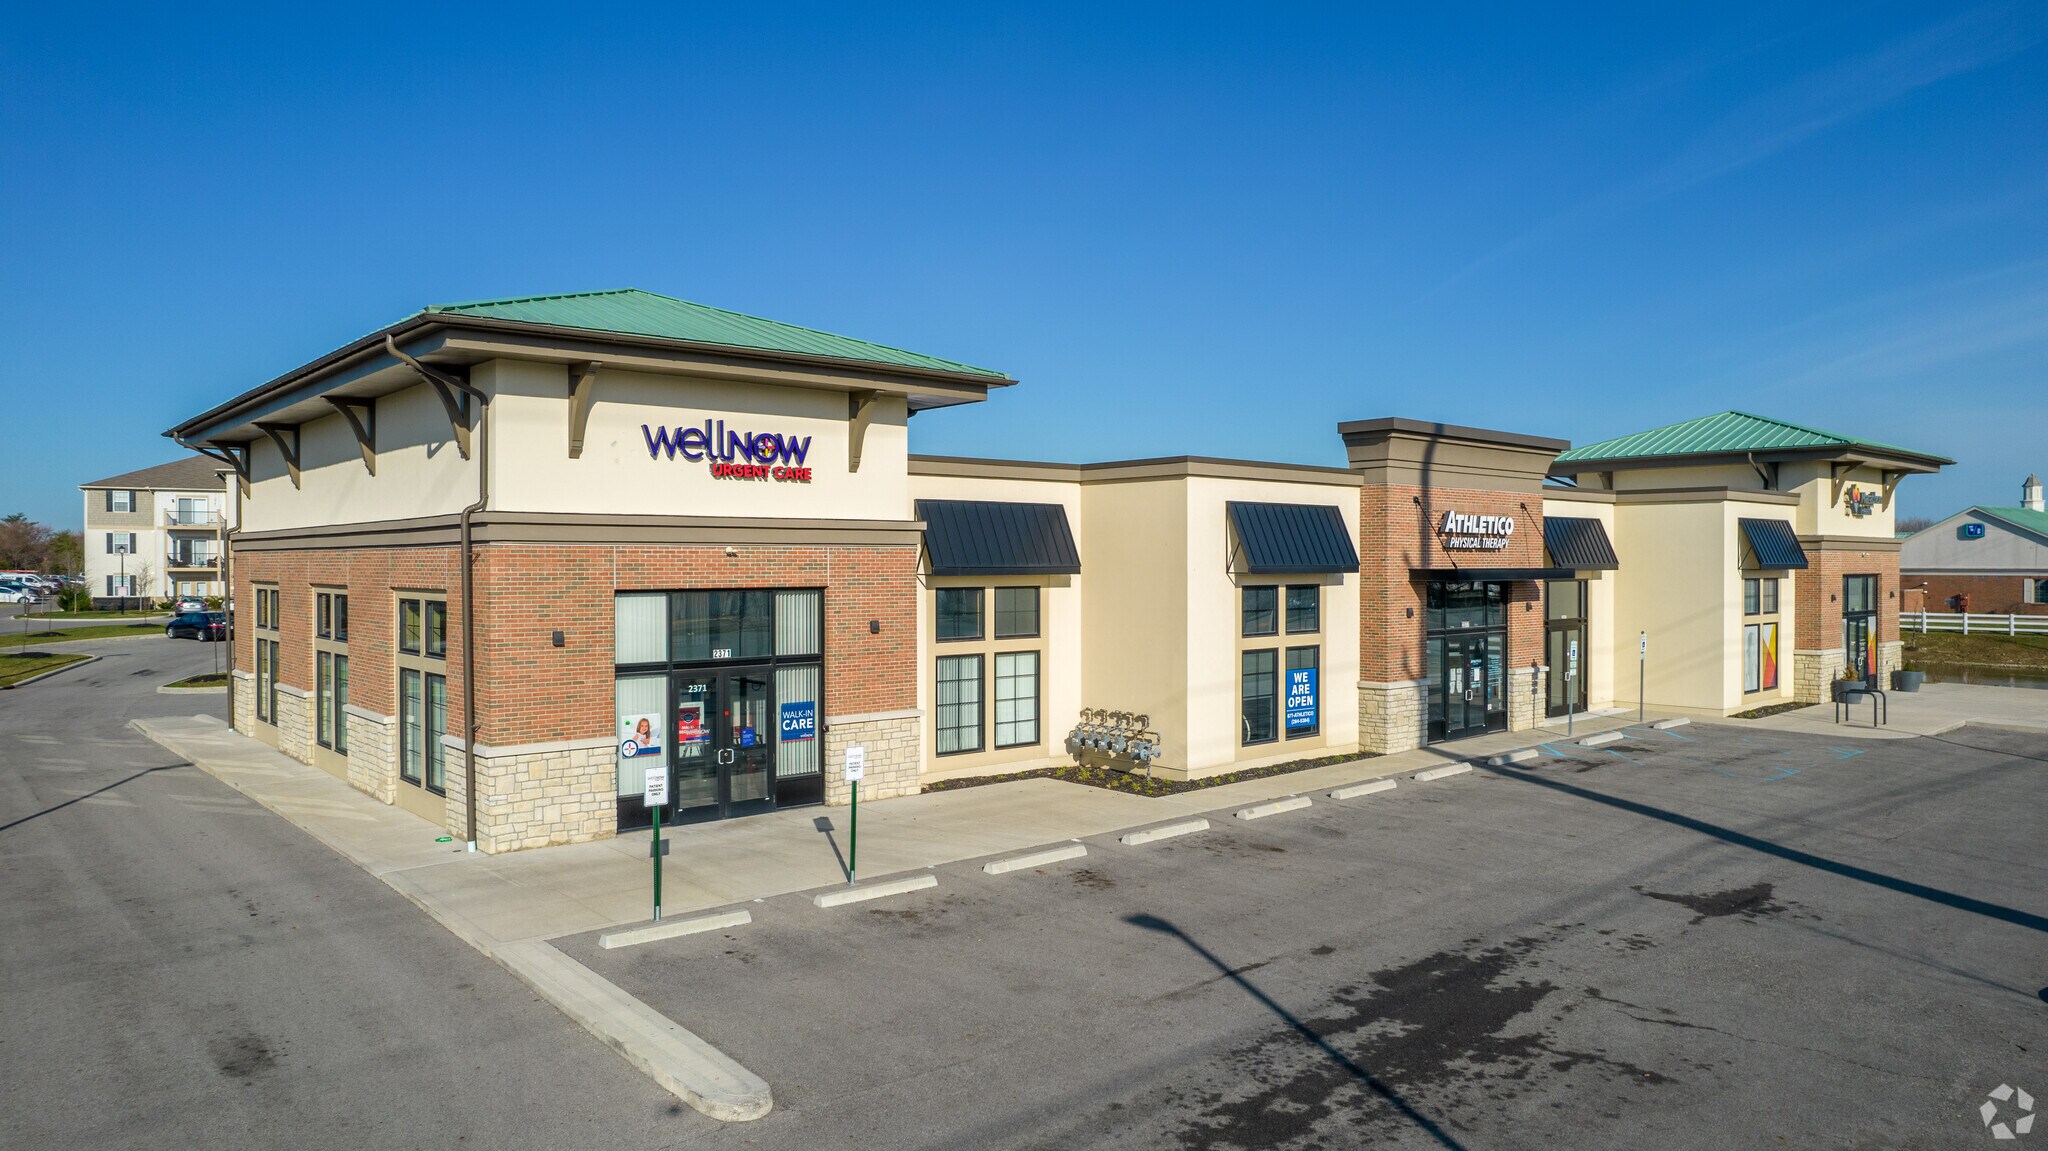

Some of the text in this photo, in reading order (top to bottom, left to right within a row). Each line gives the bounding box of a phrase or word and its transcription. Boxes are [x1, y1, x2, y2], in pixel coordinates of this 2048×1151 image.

[712, 462, 812, 482] URGENT CARE
[1449, 536, 1510, 549] PHYSICAL THERAPY
[1294, 672, 1308, 683] WE
[688, 683, 708, 693] 2371
[1291, 683, 1310, 696] ARE
[1288, 695, 1314, 708] OPEN
[782, 709, 813, 719] WALK-IN
[782, 718, 814, 731] CARE
